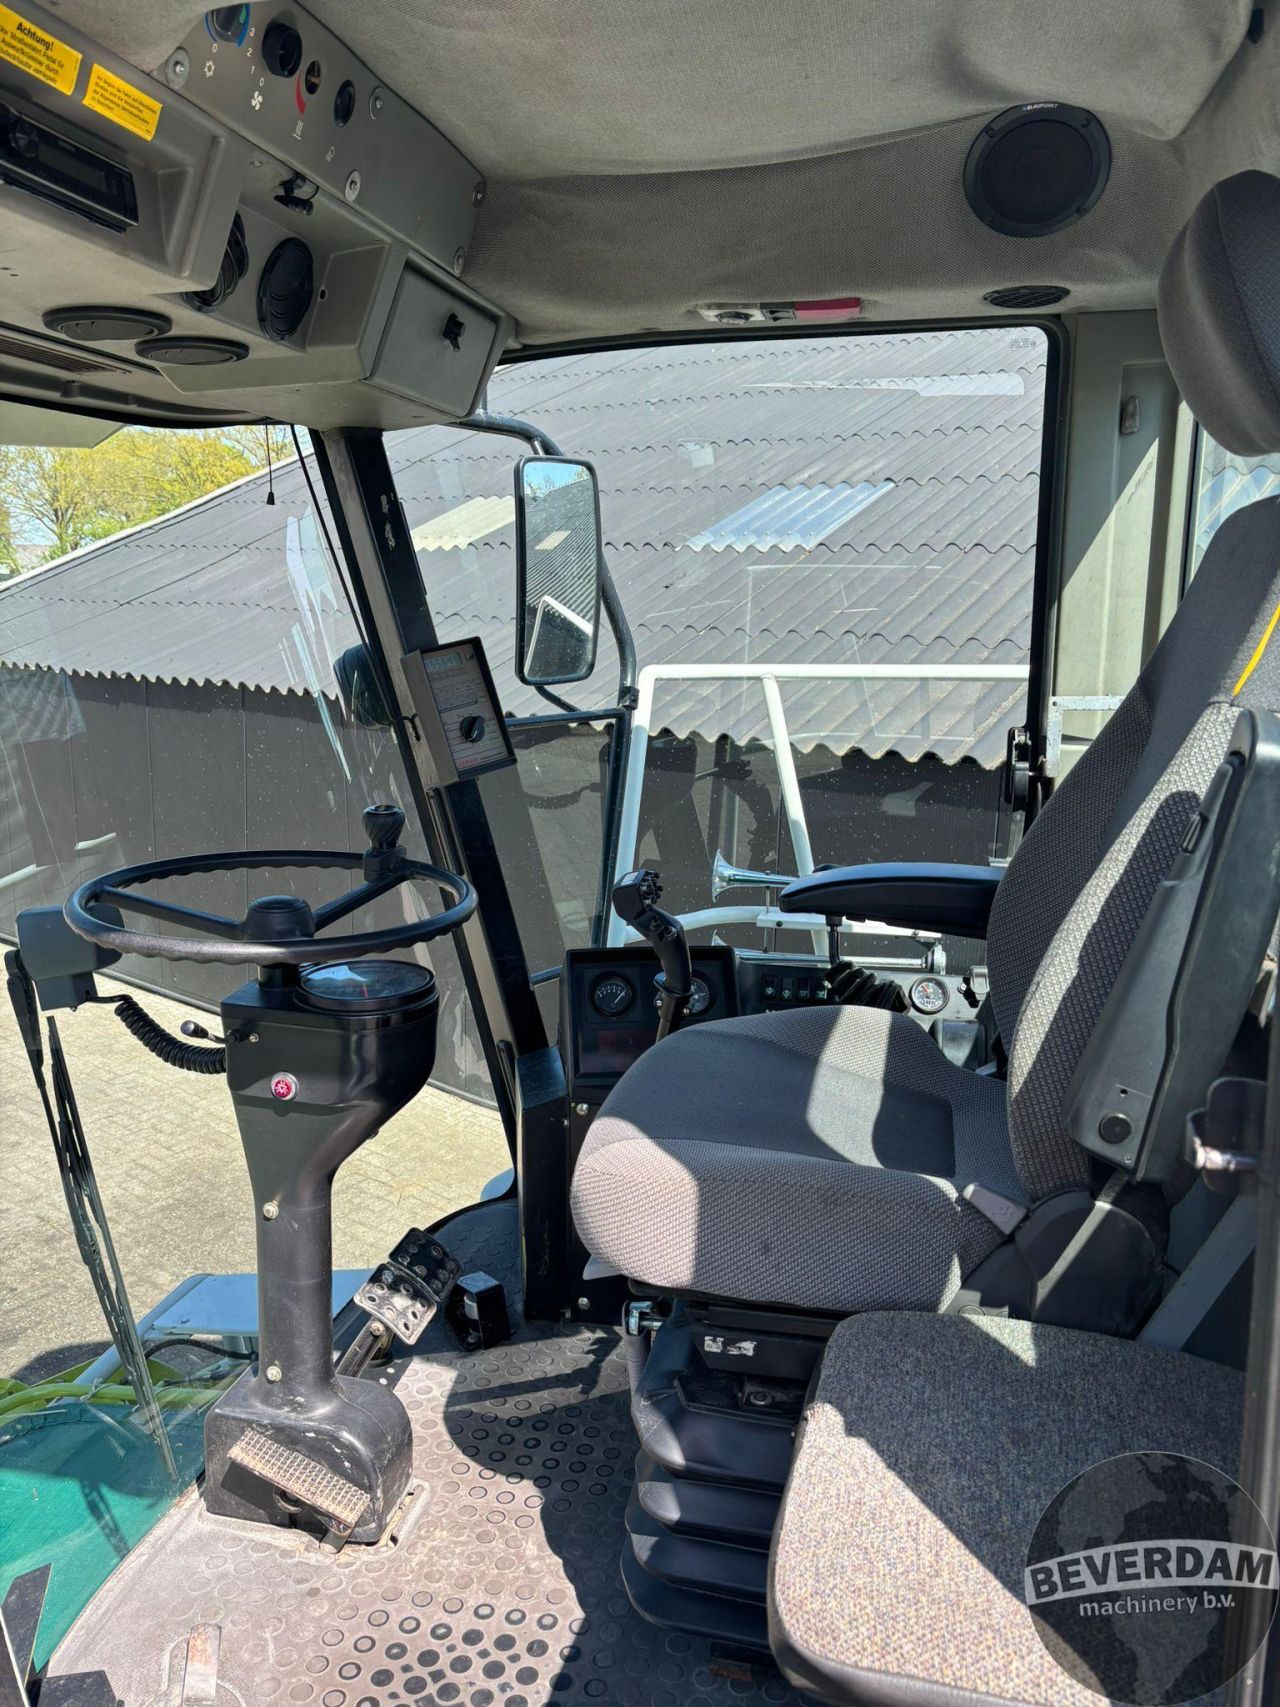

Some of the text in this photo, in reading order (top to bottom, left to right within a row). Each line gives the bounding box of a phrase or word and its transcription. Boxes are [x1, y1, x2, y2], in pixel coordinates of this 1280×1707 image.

[16, 22, 54, 51] Achtung!
[249, 27, 256, 37] 3
[212, 43, 218, 53] 0
[246, 47, 253, 57] 2
[250, 65, 255, 74] 1
[259, 77, 265, 87] 0
